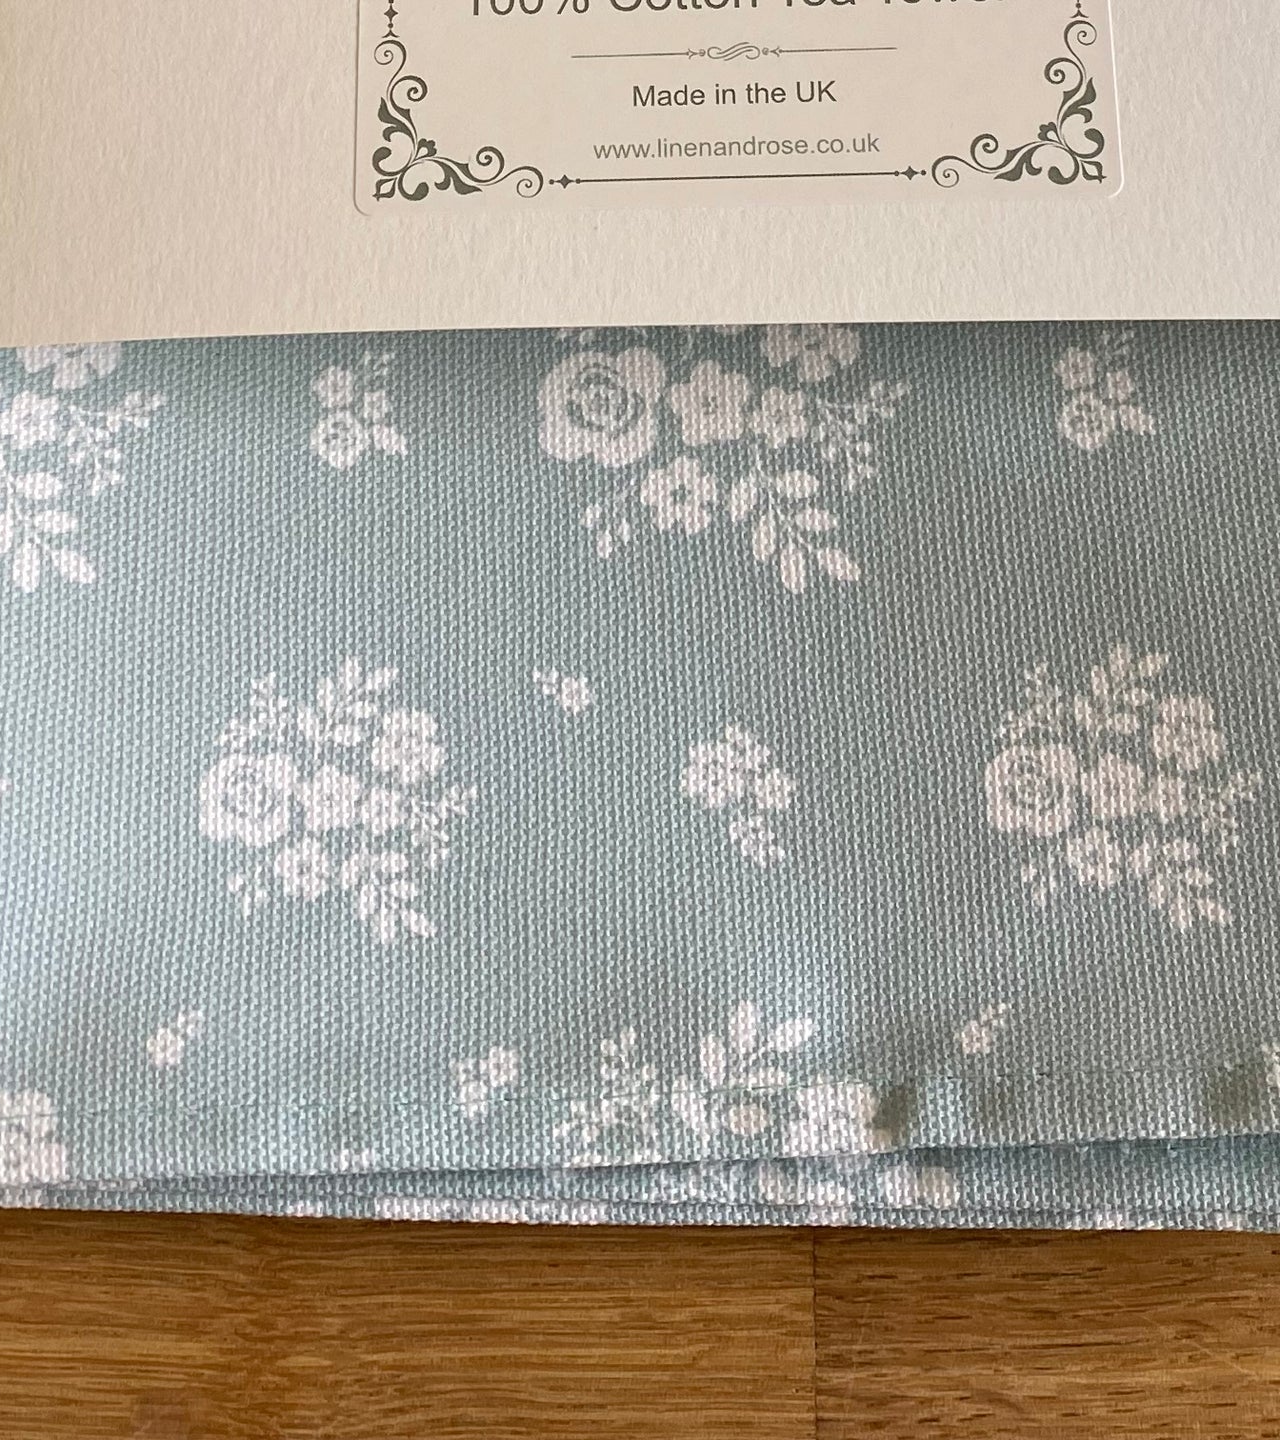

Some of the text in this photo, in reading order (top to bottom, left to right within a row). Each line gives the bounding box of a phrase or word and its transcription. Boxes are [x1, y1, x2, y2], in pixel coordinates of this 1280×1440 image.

[631, 79, 838, 107] Made in the UK
[592, 131, 881, 161] www.linenandrose.co.uk
